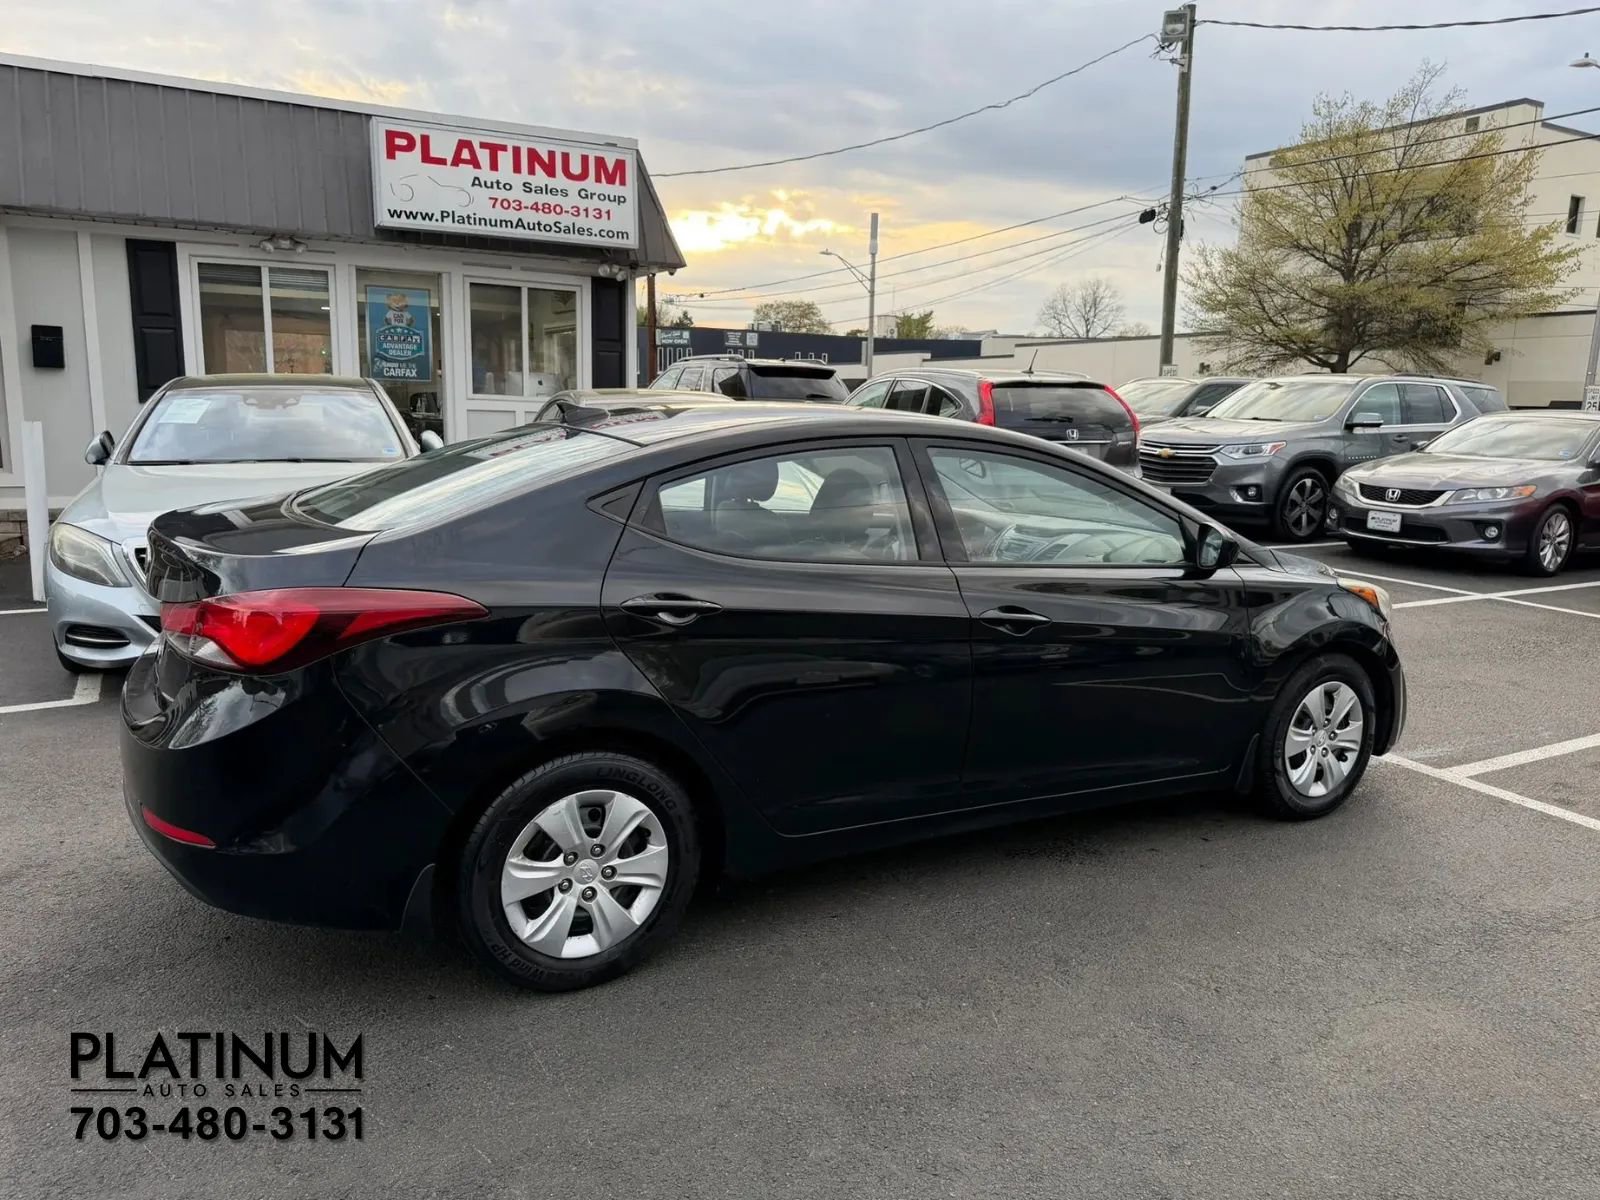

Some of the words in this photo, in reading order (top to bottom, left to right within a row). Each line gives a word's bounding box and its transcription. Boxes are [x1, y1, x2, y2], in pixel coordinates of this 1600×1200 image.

[385, 129, 627, 187] PLATINUM
[471, 176, 513, 192] Auto
[522, 181, 569, 198] Sales
[578, 188, 627, 205] Group
[488, 197, 612, 221] 703-480-3131
[387, 207, 629, 241] www.PlatinumAutoSales.com
[379, 335, 421, 343] CARFAX
[382, 342, 417, 350] ADVANTAGE
[383, 367, 417, 377] CARFAX
[596, 767, 677, 811] LINGLONG
